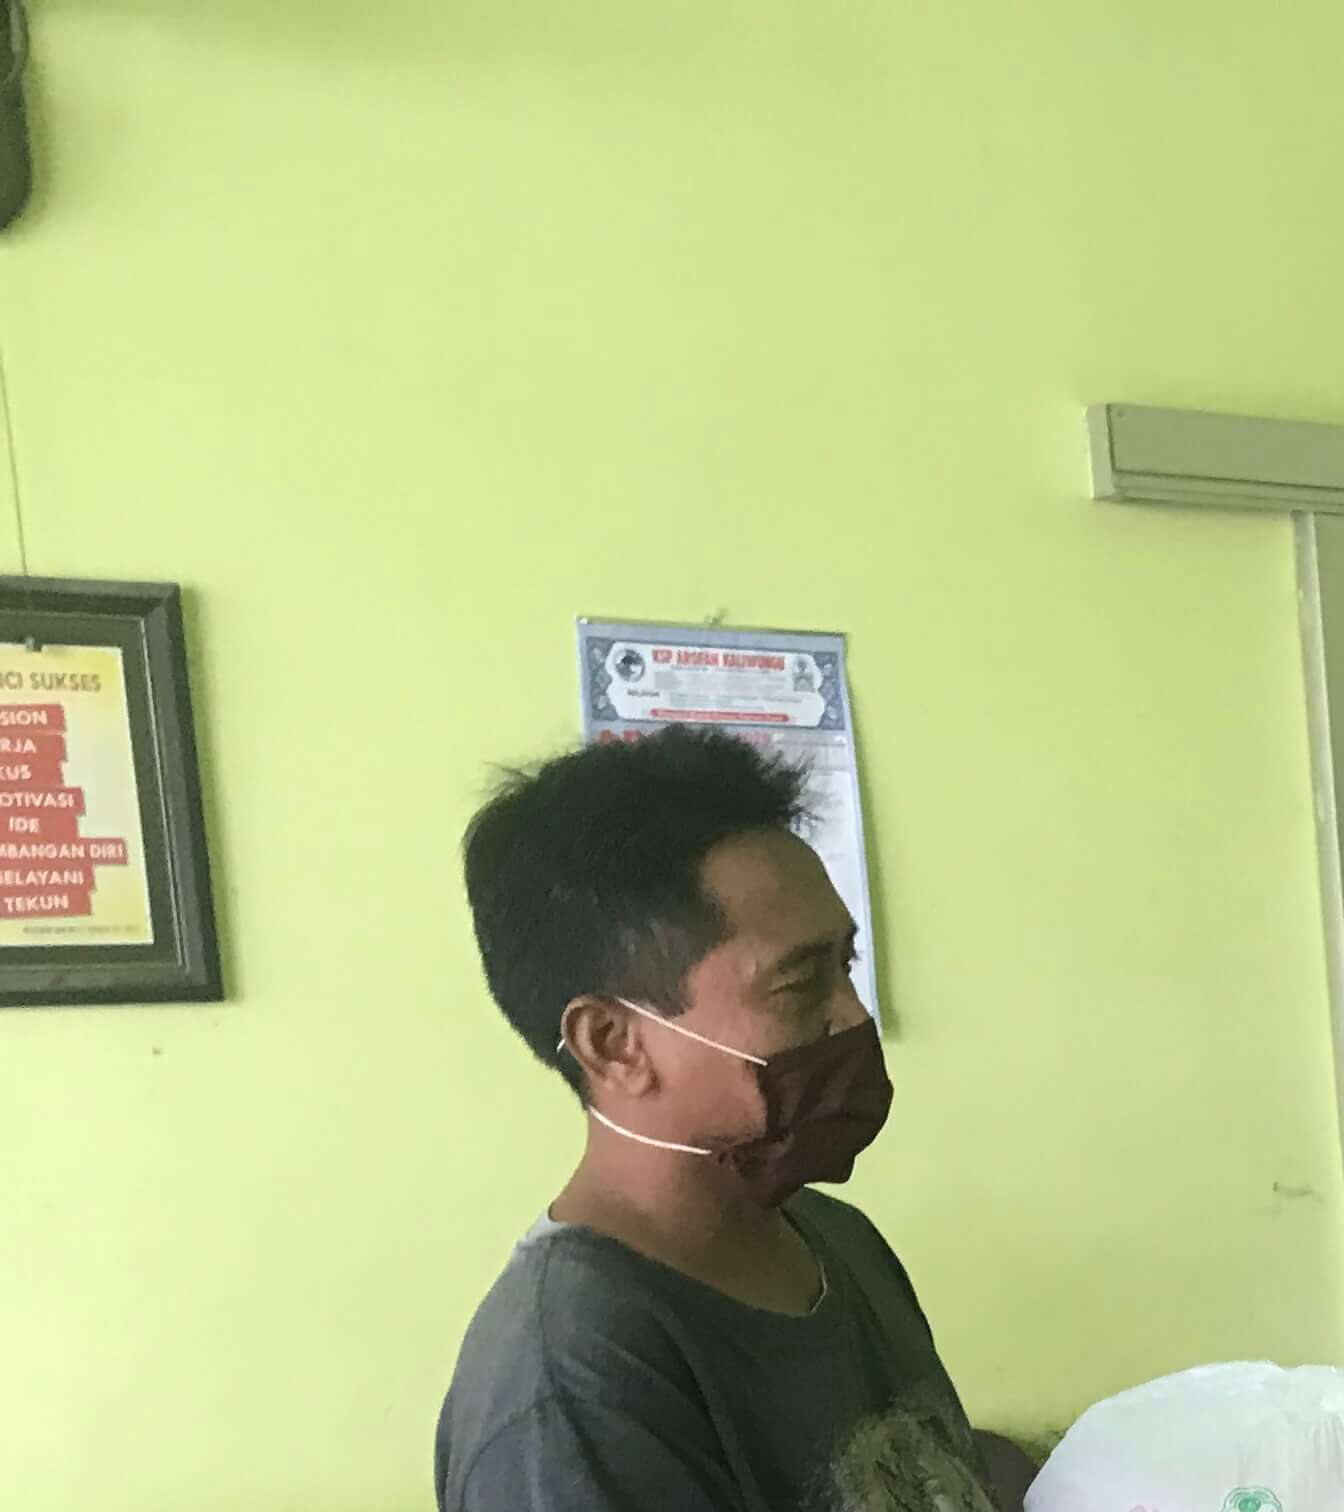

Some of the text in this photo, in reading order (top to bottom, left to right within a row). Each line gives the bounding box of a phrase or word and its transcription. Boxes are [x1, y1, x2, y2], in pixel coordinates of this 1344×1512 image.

[30, 671, 102, 692] SUKSES
[8, 816, 40, 833] IDE
[89, 843, 123, 859] DIRI
[0, 869, 84, 886] ELAYANI
[4, 894, 69, 912] TEKUN
